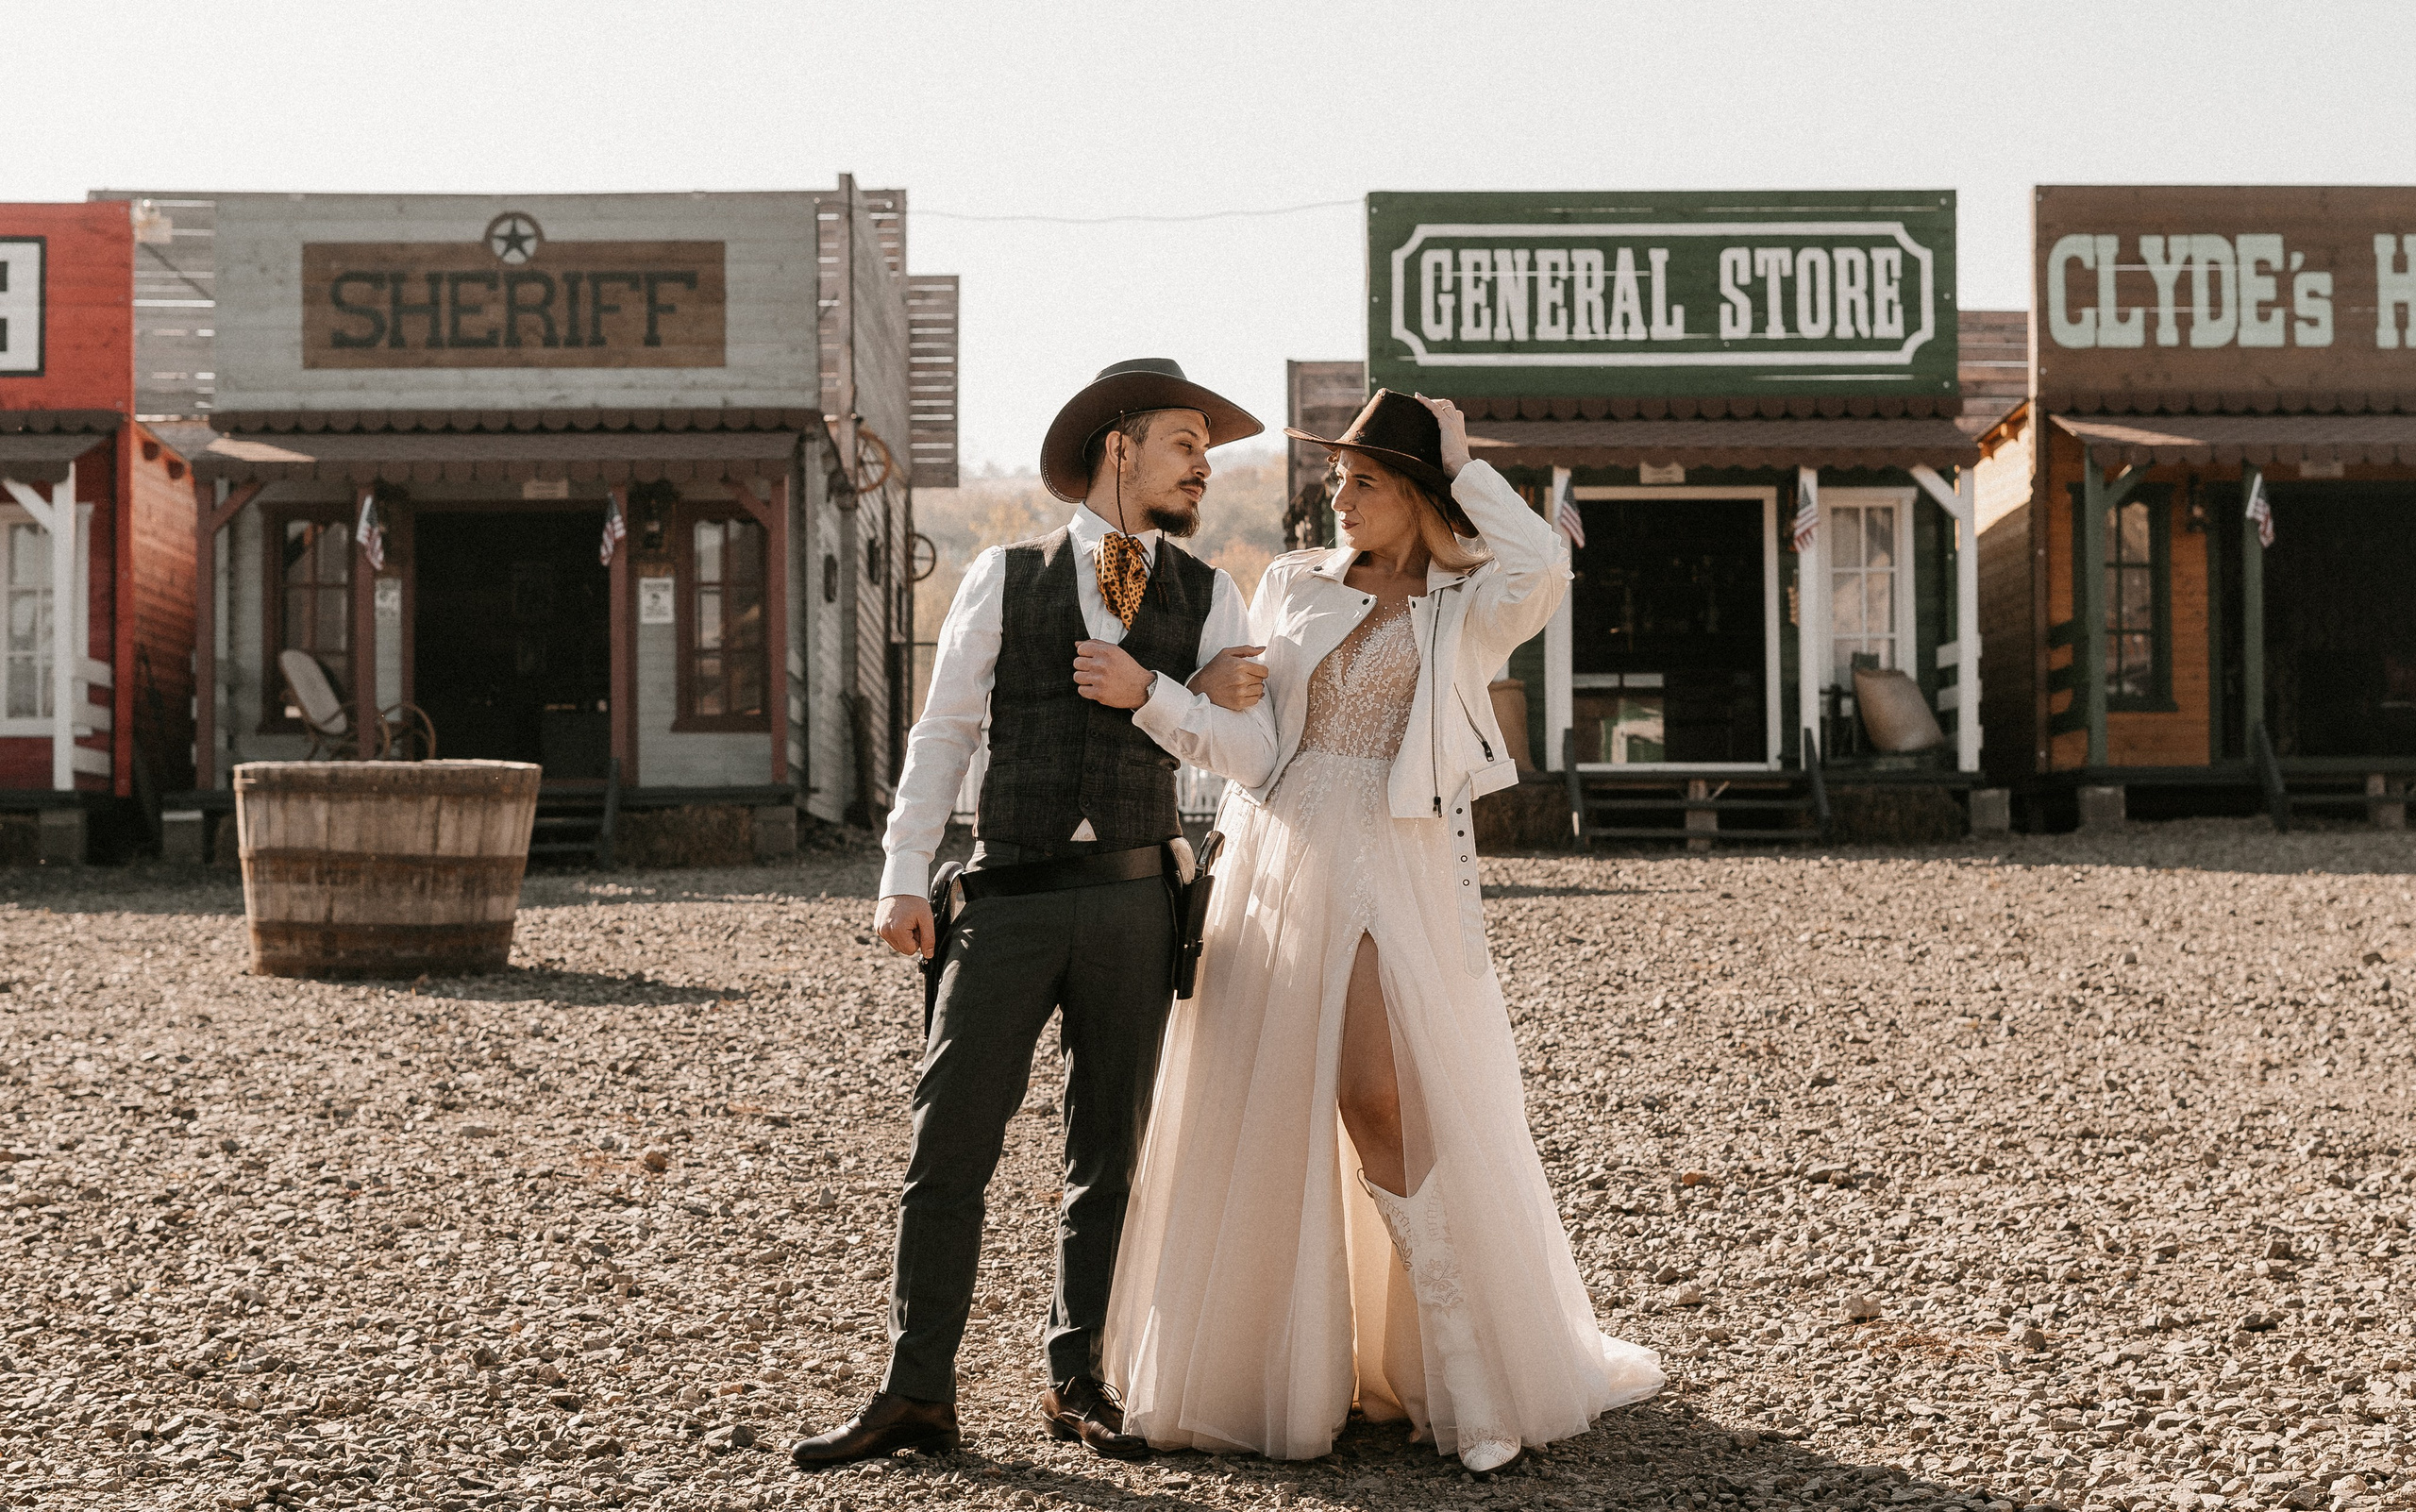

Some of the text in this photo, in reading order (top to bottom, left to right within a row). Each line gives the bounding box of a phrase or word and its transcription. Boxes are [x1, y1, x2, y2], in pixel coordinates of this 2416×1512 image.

[329, 270, 699, 348] SHERIFF
[1420, 246, 1904, 342] GENERAL STORE
[2047, 233, 2334, 349] CLYDE's
